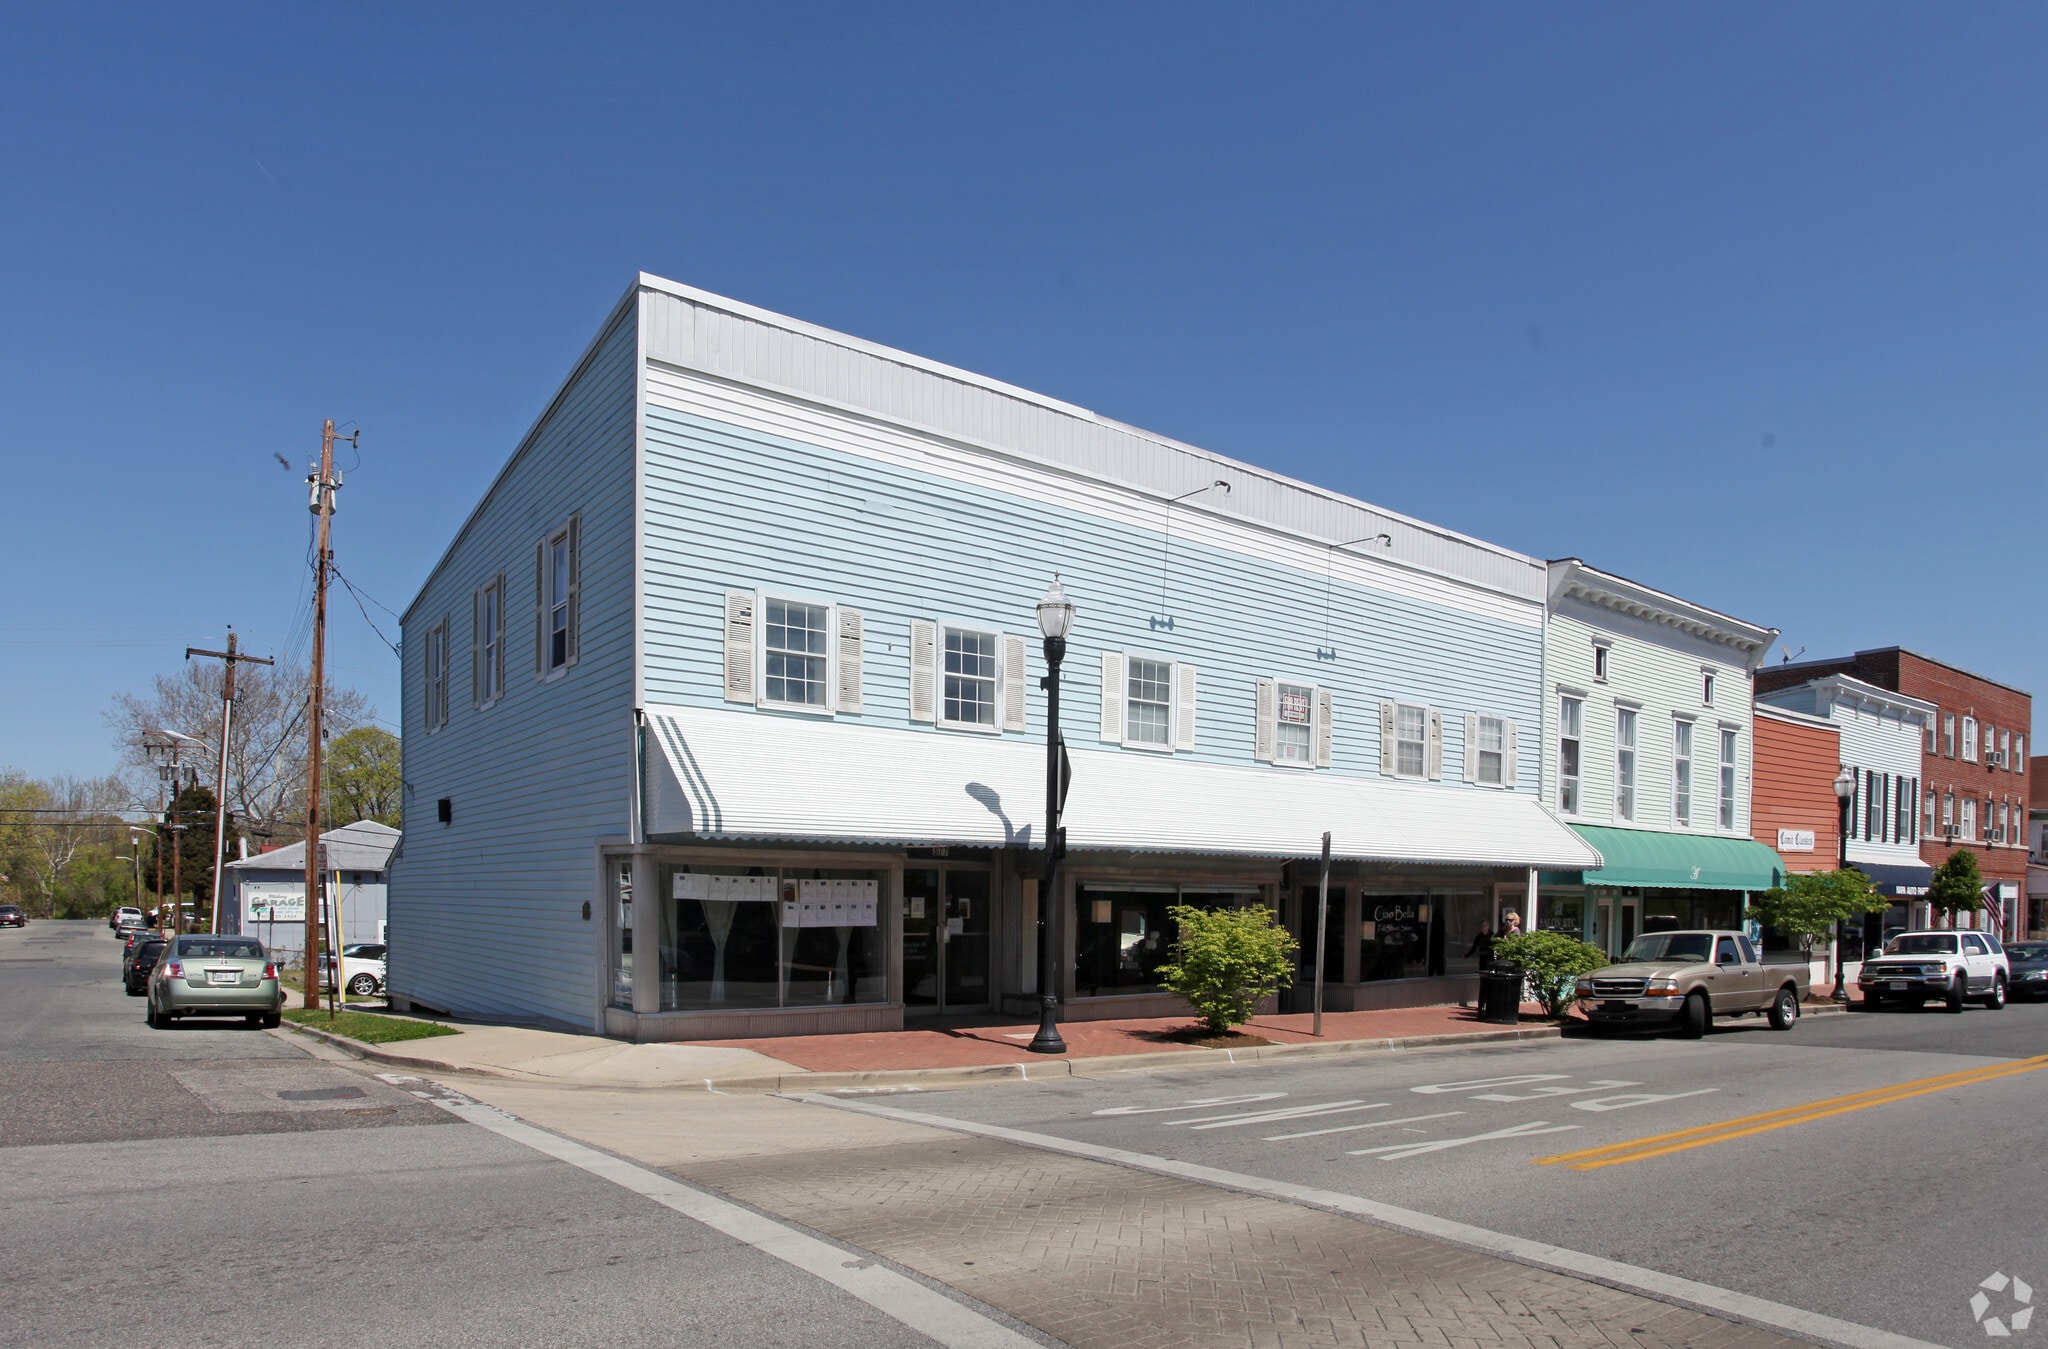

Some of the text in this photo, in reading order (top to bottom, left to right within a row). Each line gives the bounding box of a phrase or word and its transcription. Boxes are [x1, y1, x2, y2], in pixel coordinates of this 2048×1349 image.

[251, 896, 304, 907] GARAGE
[1374, 904, 1415, 922] Ciao Bella
